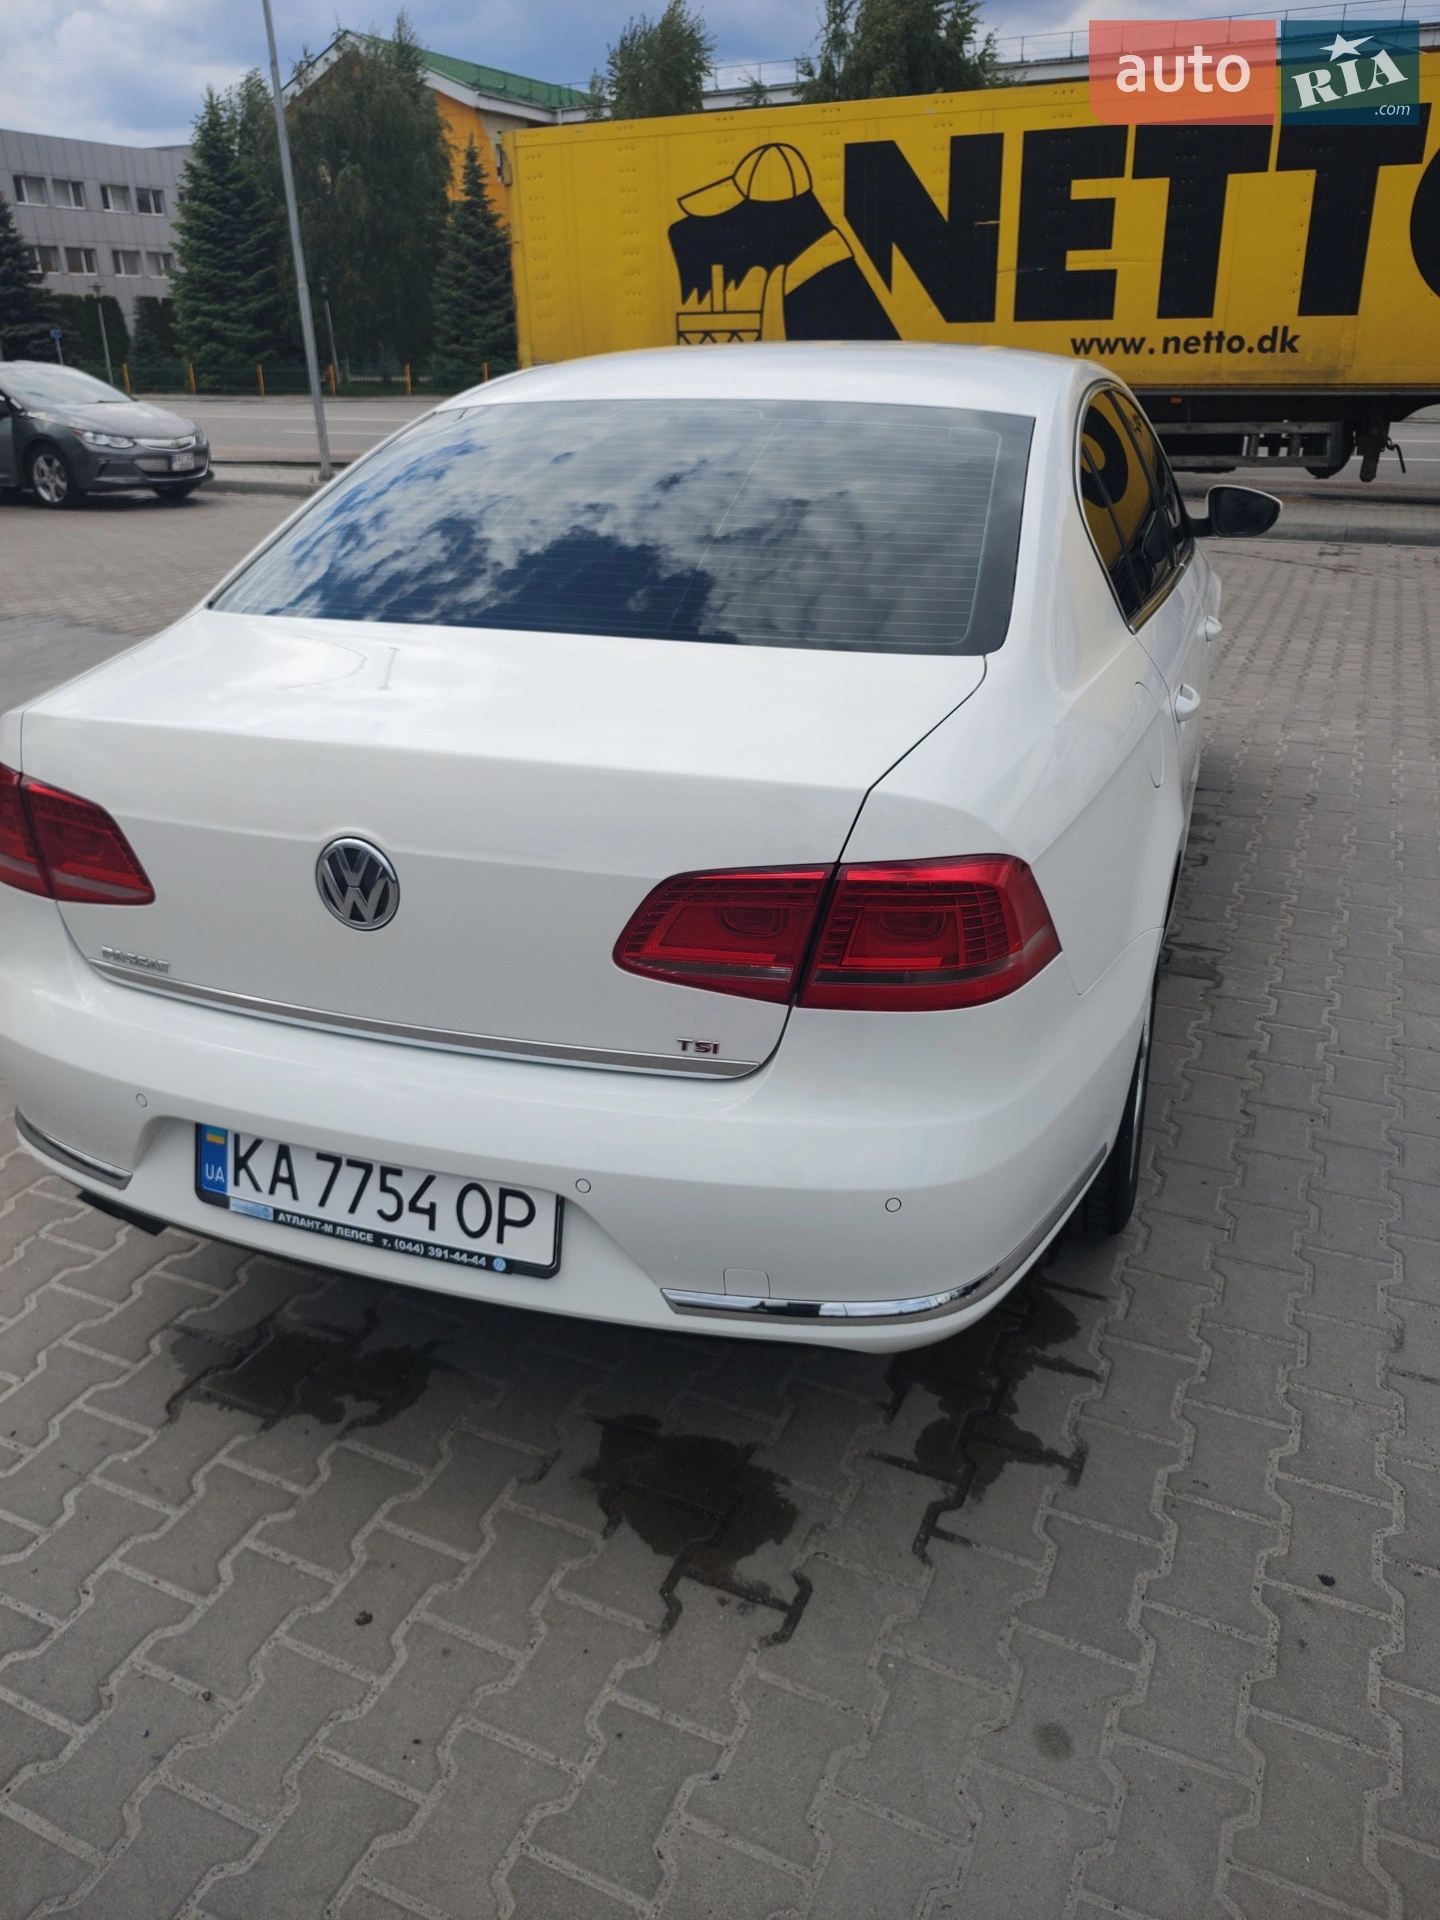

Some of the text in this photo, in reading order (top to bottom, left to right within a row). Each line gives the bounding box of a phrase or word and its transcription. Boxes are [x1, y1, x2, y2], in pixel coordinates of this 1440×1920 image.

[844, 103, 1440, 323] NETT
[1070, 325, 1300, 355] www.netto.dk
[676, 1037, 720, 1054] TSI
[205, 1162, 225, 1183] UA
[233, 1132, 537, 1245] KA 7754 OP
[278, 1212, 334, 1234] АТЛАНТ-М
[335, 1226, 374, 1243] ЛЕПСЕ
[394, 1238, 424, 1255] (044)
[427, 1246, 487, 1266] 391-44-44
